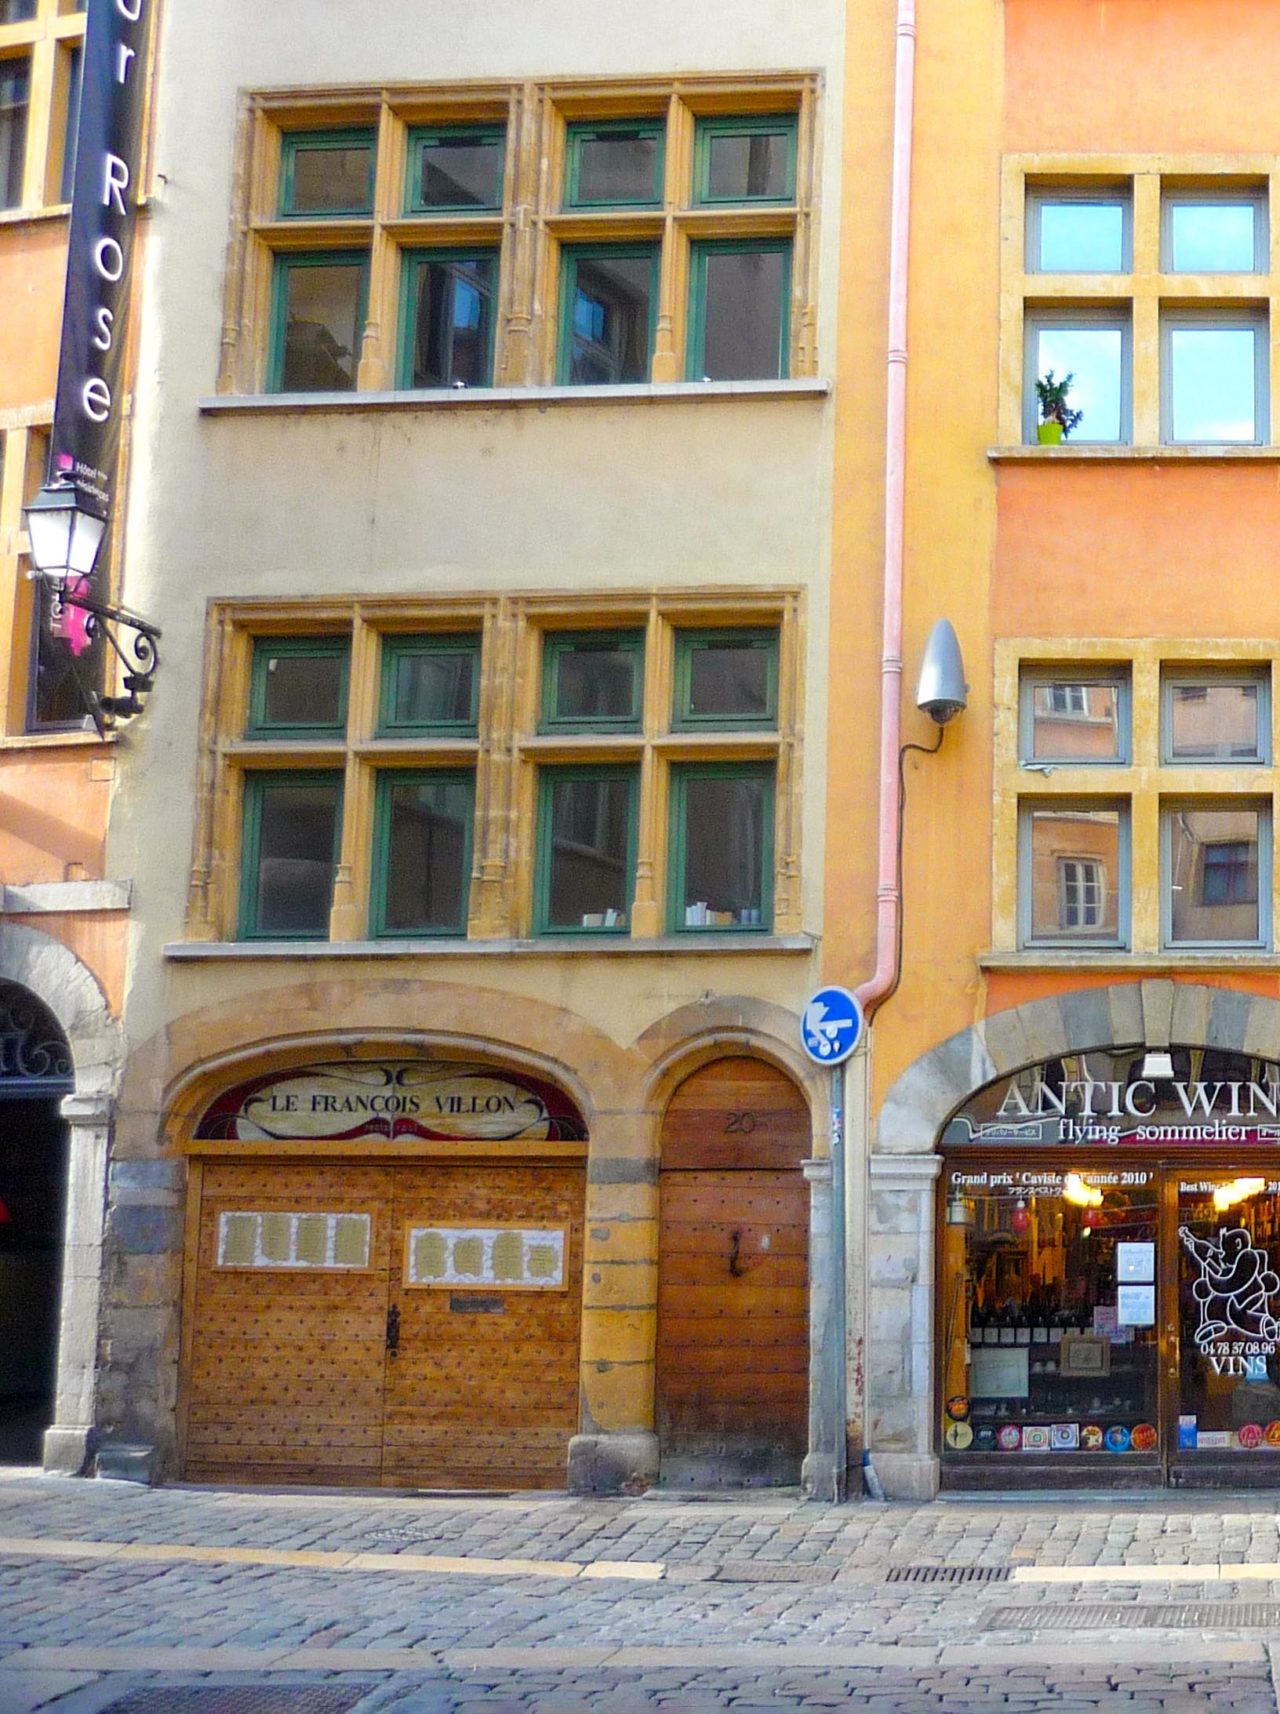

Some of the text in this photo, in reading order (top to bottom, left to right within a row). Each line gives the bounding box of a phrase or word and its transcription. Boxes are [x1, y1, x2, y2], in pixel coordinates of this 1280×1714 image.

[82, 153, 130, 422] Rose
[271, 1095, 299, 1112] LE
[435, 1095, 516, 1113] VILLON
[996, 1080, 1157, 1117] ANTIC
[1057, 1118, 1252, 1144] flying sommelier
[952, 1172, 988, 1184] Grand
[990, 1172, 1014, 1187] prix
[1021, 1172, 1062, 1184] Caviste
[1121, 1173, 1148, 1184] 2010
[1201, 1342, 1276, 1354] 04 78 37 08 96
[1209, 1355, 1268, 1375] VINS
